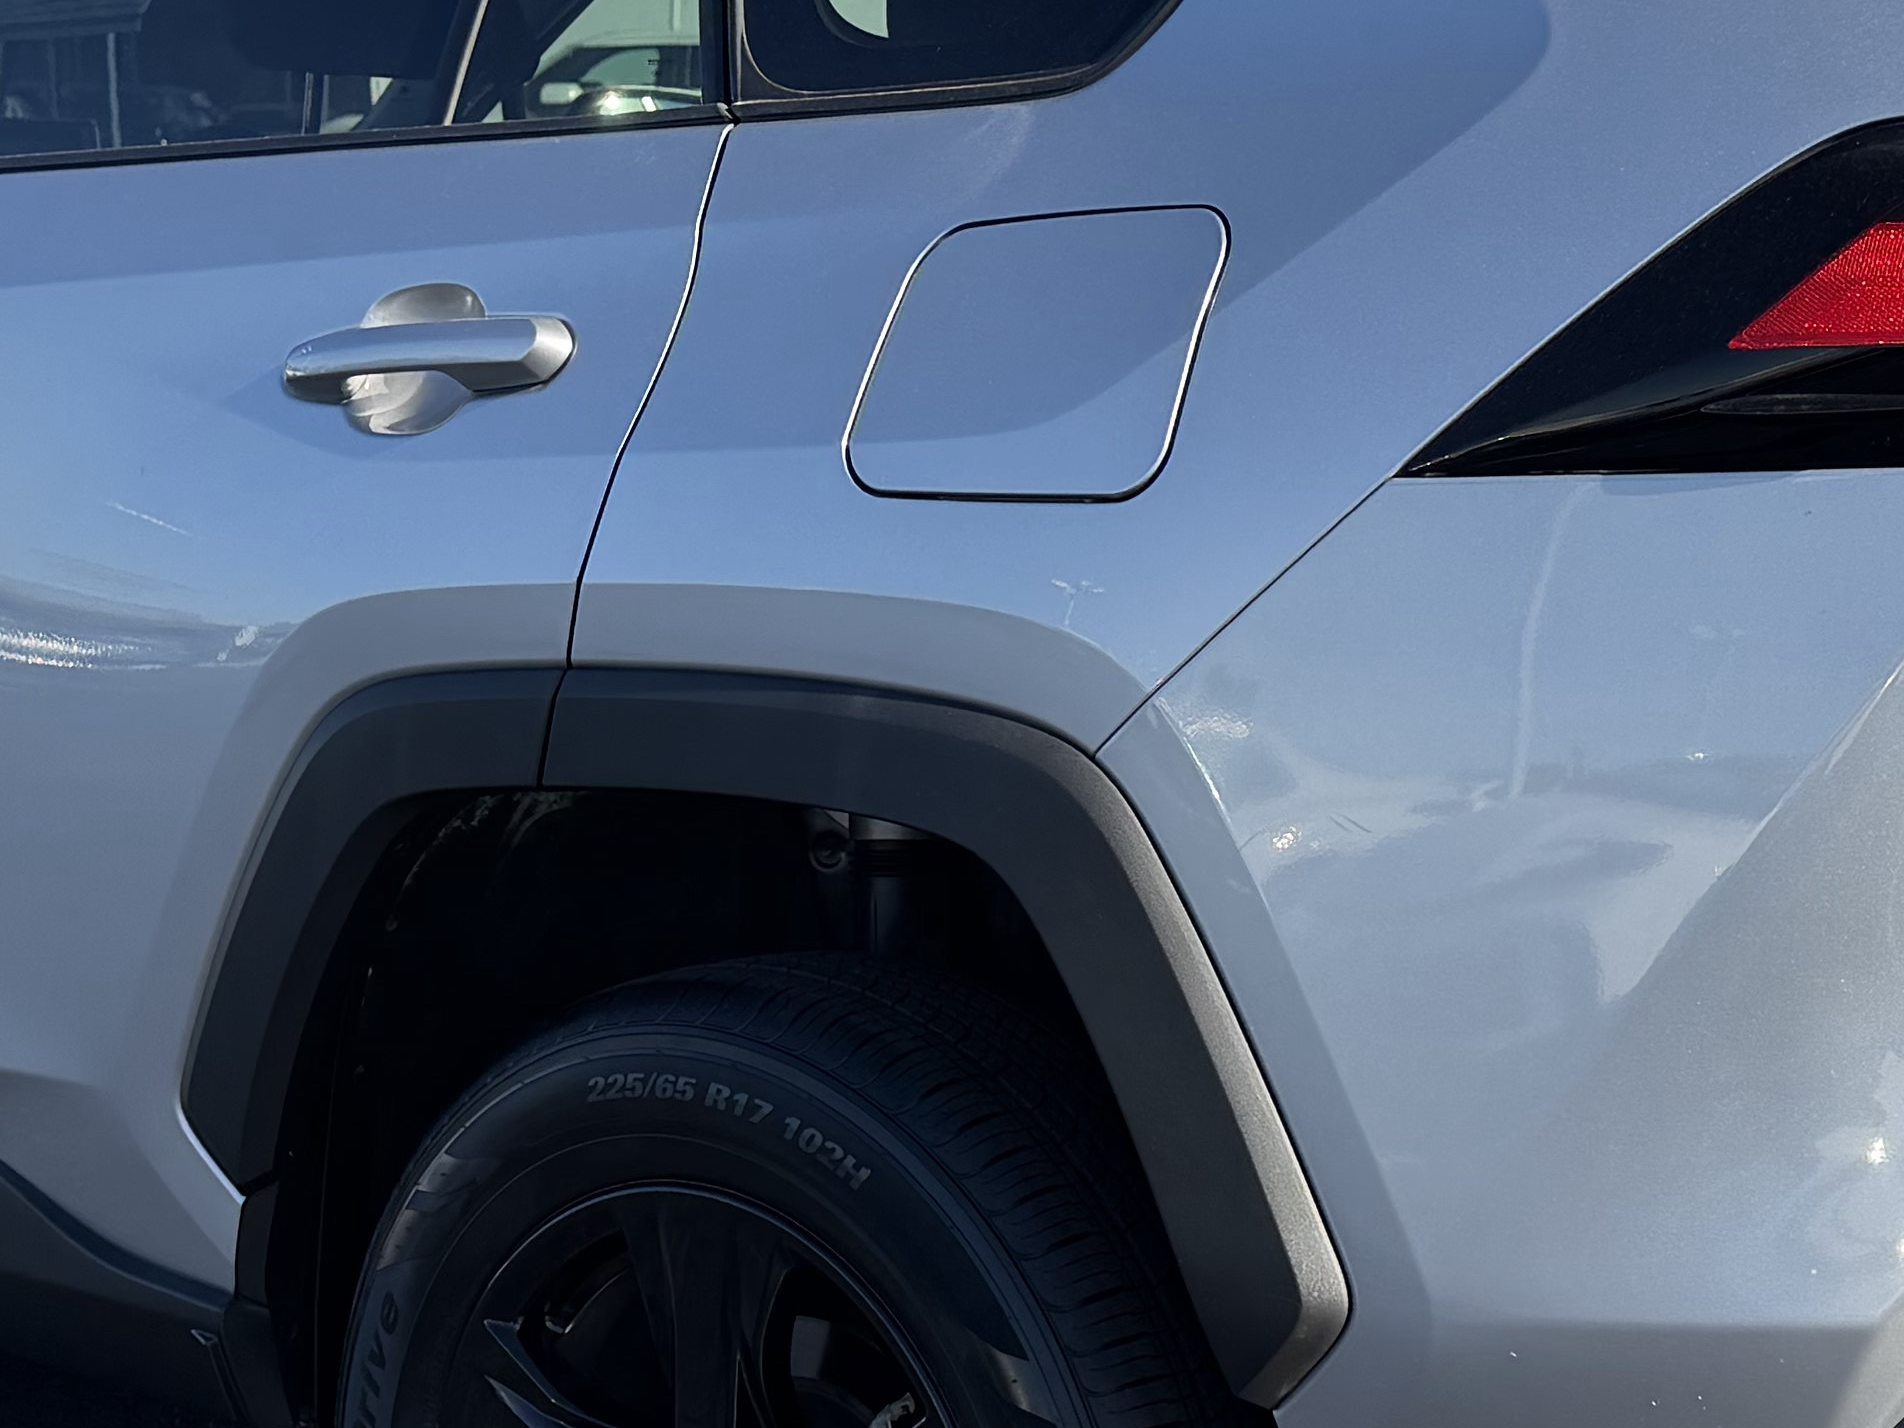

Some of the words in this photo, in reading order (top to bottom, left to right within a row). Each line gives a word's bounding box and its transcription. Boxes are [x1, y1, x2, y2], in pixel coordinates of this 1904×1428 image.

[586, 1072, 696, 1103] 225/65
[704, 1082, 775, 1123] R17
[782, 1117, 872, 1191] 102H
